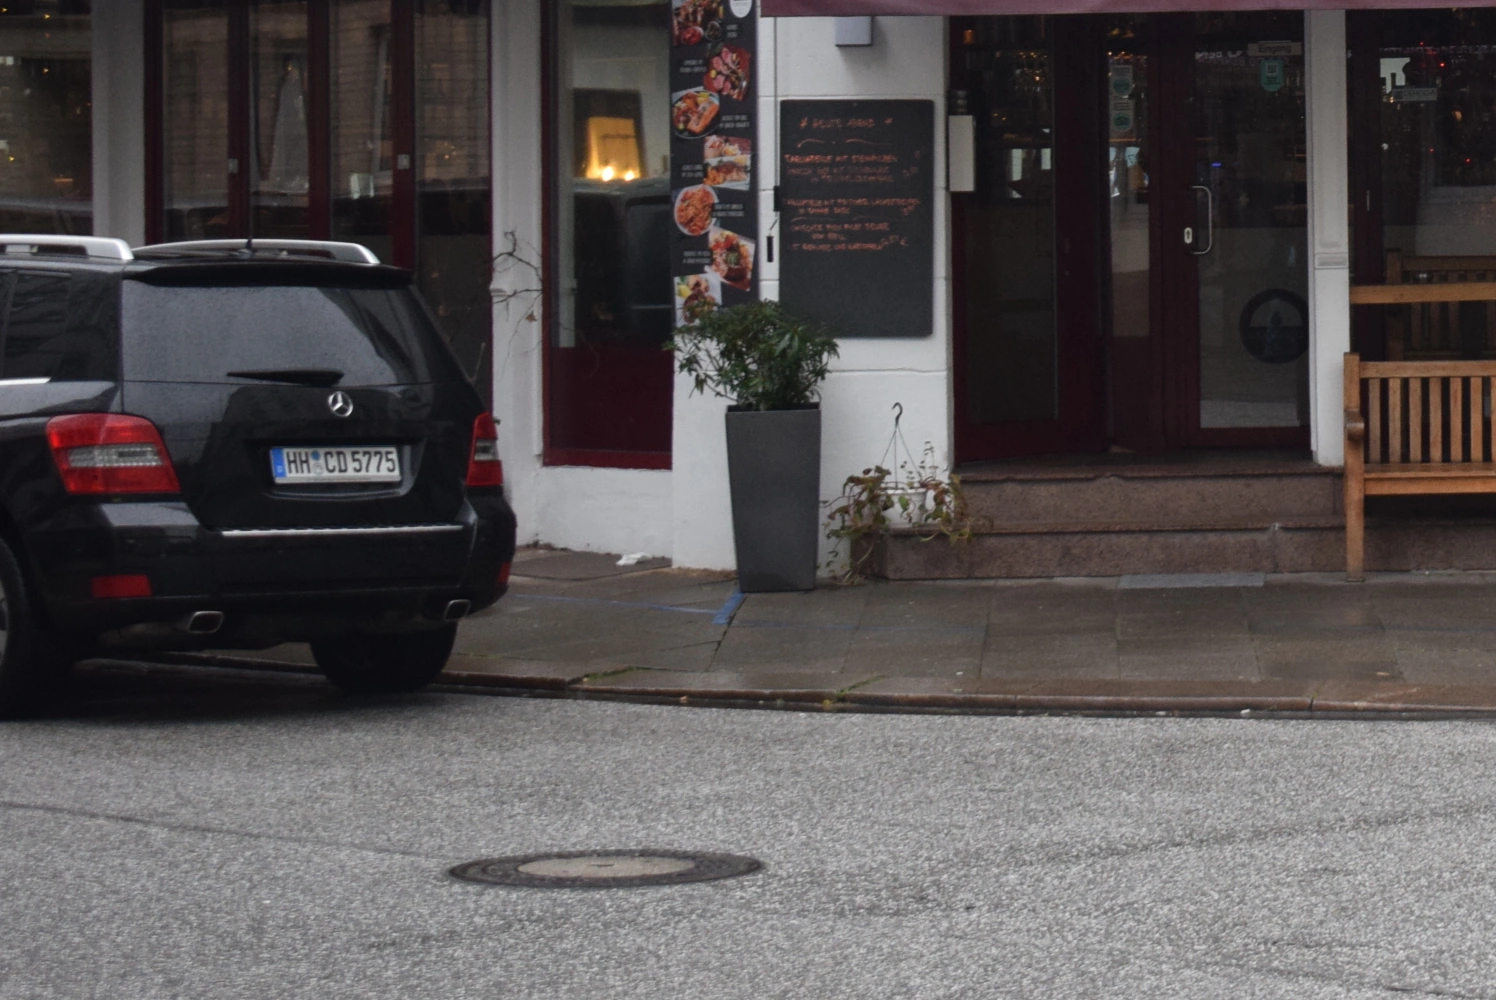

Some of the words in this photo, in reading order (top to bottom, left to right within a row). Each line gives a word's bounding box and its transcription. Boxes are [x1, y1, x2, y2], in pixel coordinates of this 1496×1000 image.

[1258, 44, 1292, 55] Eingang
[286, 451, 311, 474] HH
[323, 451, 348, 473] CD
[350, 450, 397, 473] 5775
